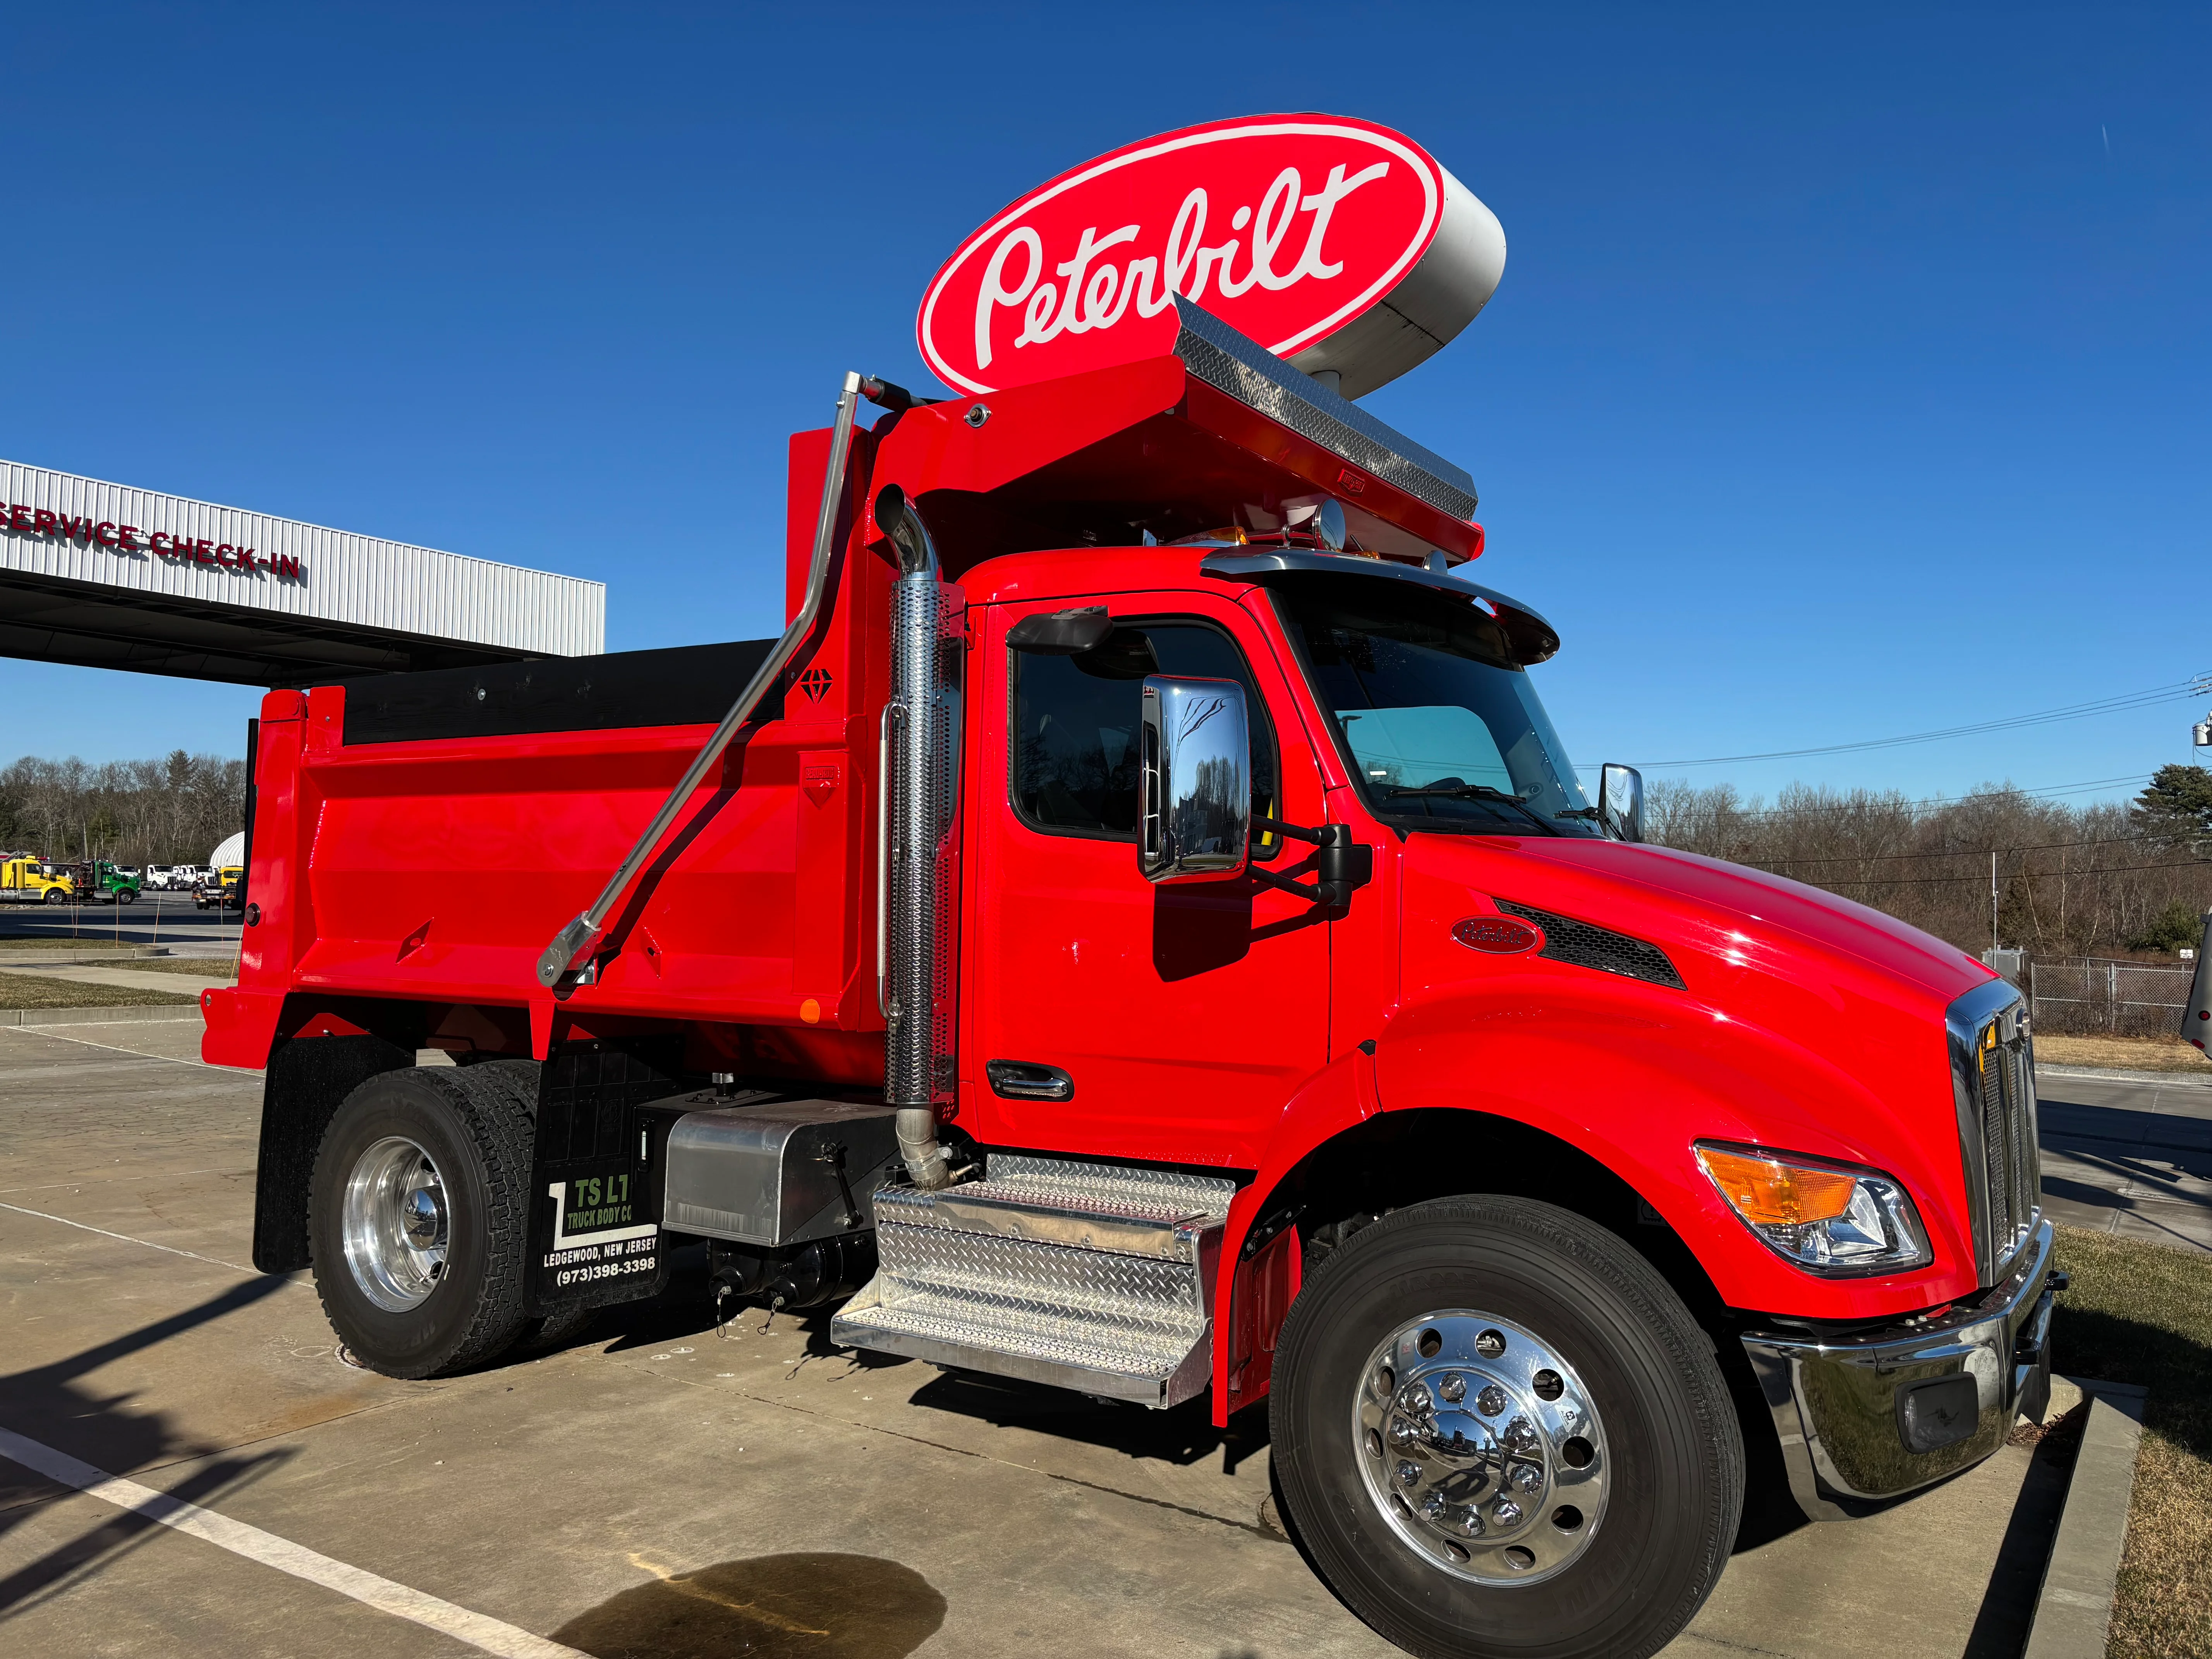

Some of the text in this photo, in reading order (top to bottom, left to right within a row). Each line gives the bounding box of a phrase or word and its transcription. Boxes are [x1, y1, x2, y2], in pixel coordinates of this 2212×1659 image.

[975, 161, 1389, 369] Peterbilt
[149, 532, 299, 578] CHECK-IN
[1461, 922, 1530, 944] Peterbilt
[568, 1210, 596, 1229] TRUCK
[597, 1207, 620, 1225] BODY
[544, 1237, 656, 1267] LEDGEWOOD, NEW JERSEY
[557, 1257, 655, 1287] (973)398-3398
[1561, 1410, 1569, 1425] ALCOA
